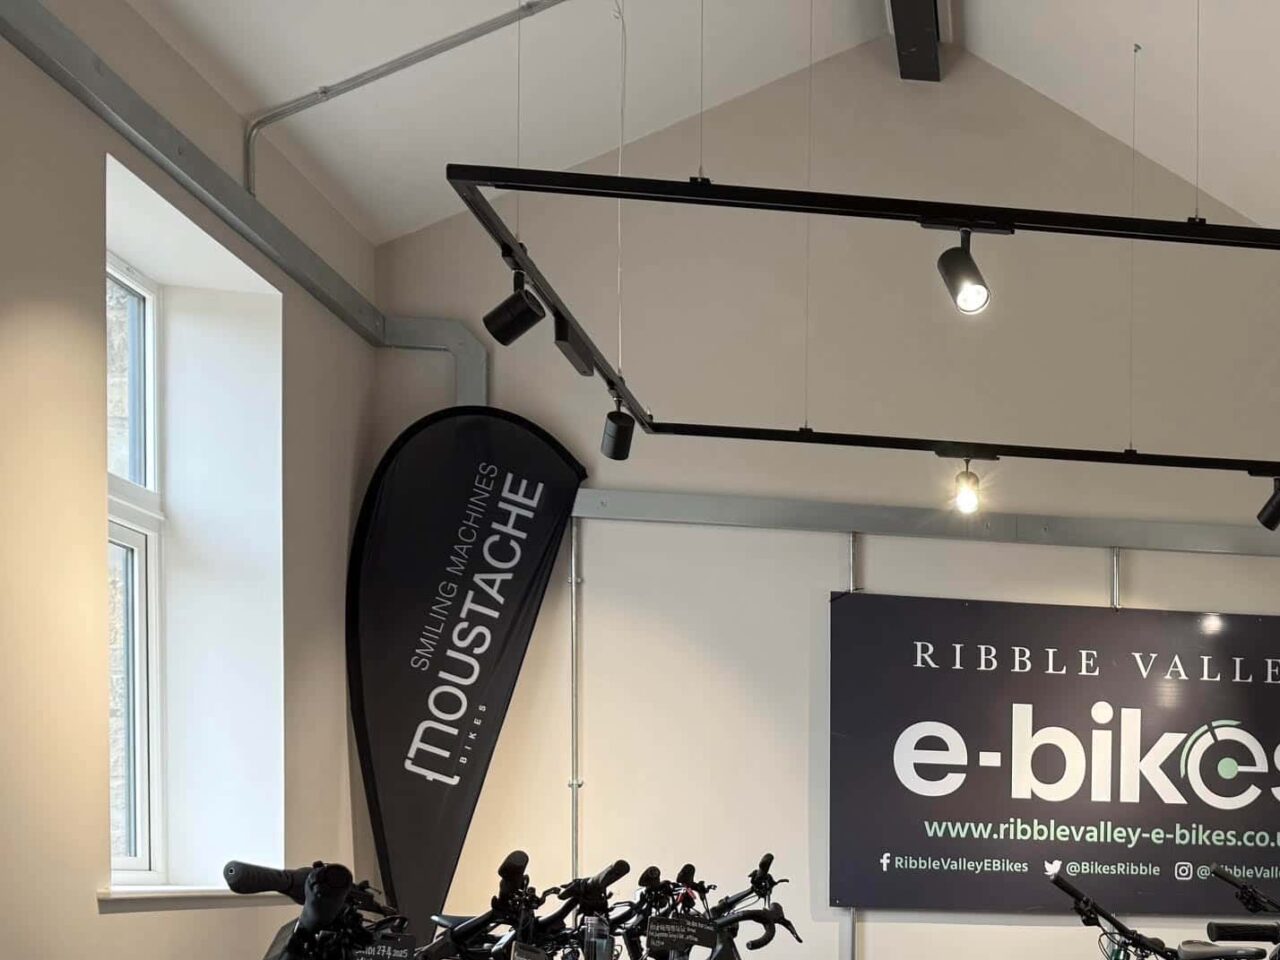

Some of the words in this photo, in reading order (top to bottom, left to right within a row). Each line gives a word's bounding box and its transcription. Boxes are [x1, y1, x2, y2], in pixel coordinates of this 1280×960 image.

[410, 580, 459, 671] SMILING
[445, 462, 498, 577] MACHINES
[405, 472, 544, 785] MOUSTACHE
[913, 641, 1099, 676] RIBBLE
[459, 704, 487, 764] BIKES
[894, 856, 1029, 874] RibbleValleyEBikes
[1066, 861, 1160, 876] @BikesRibble
